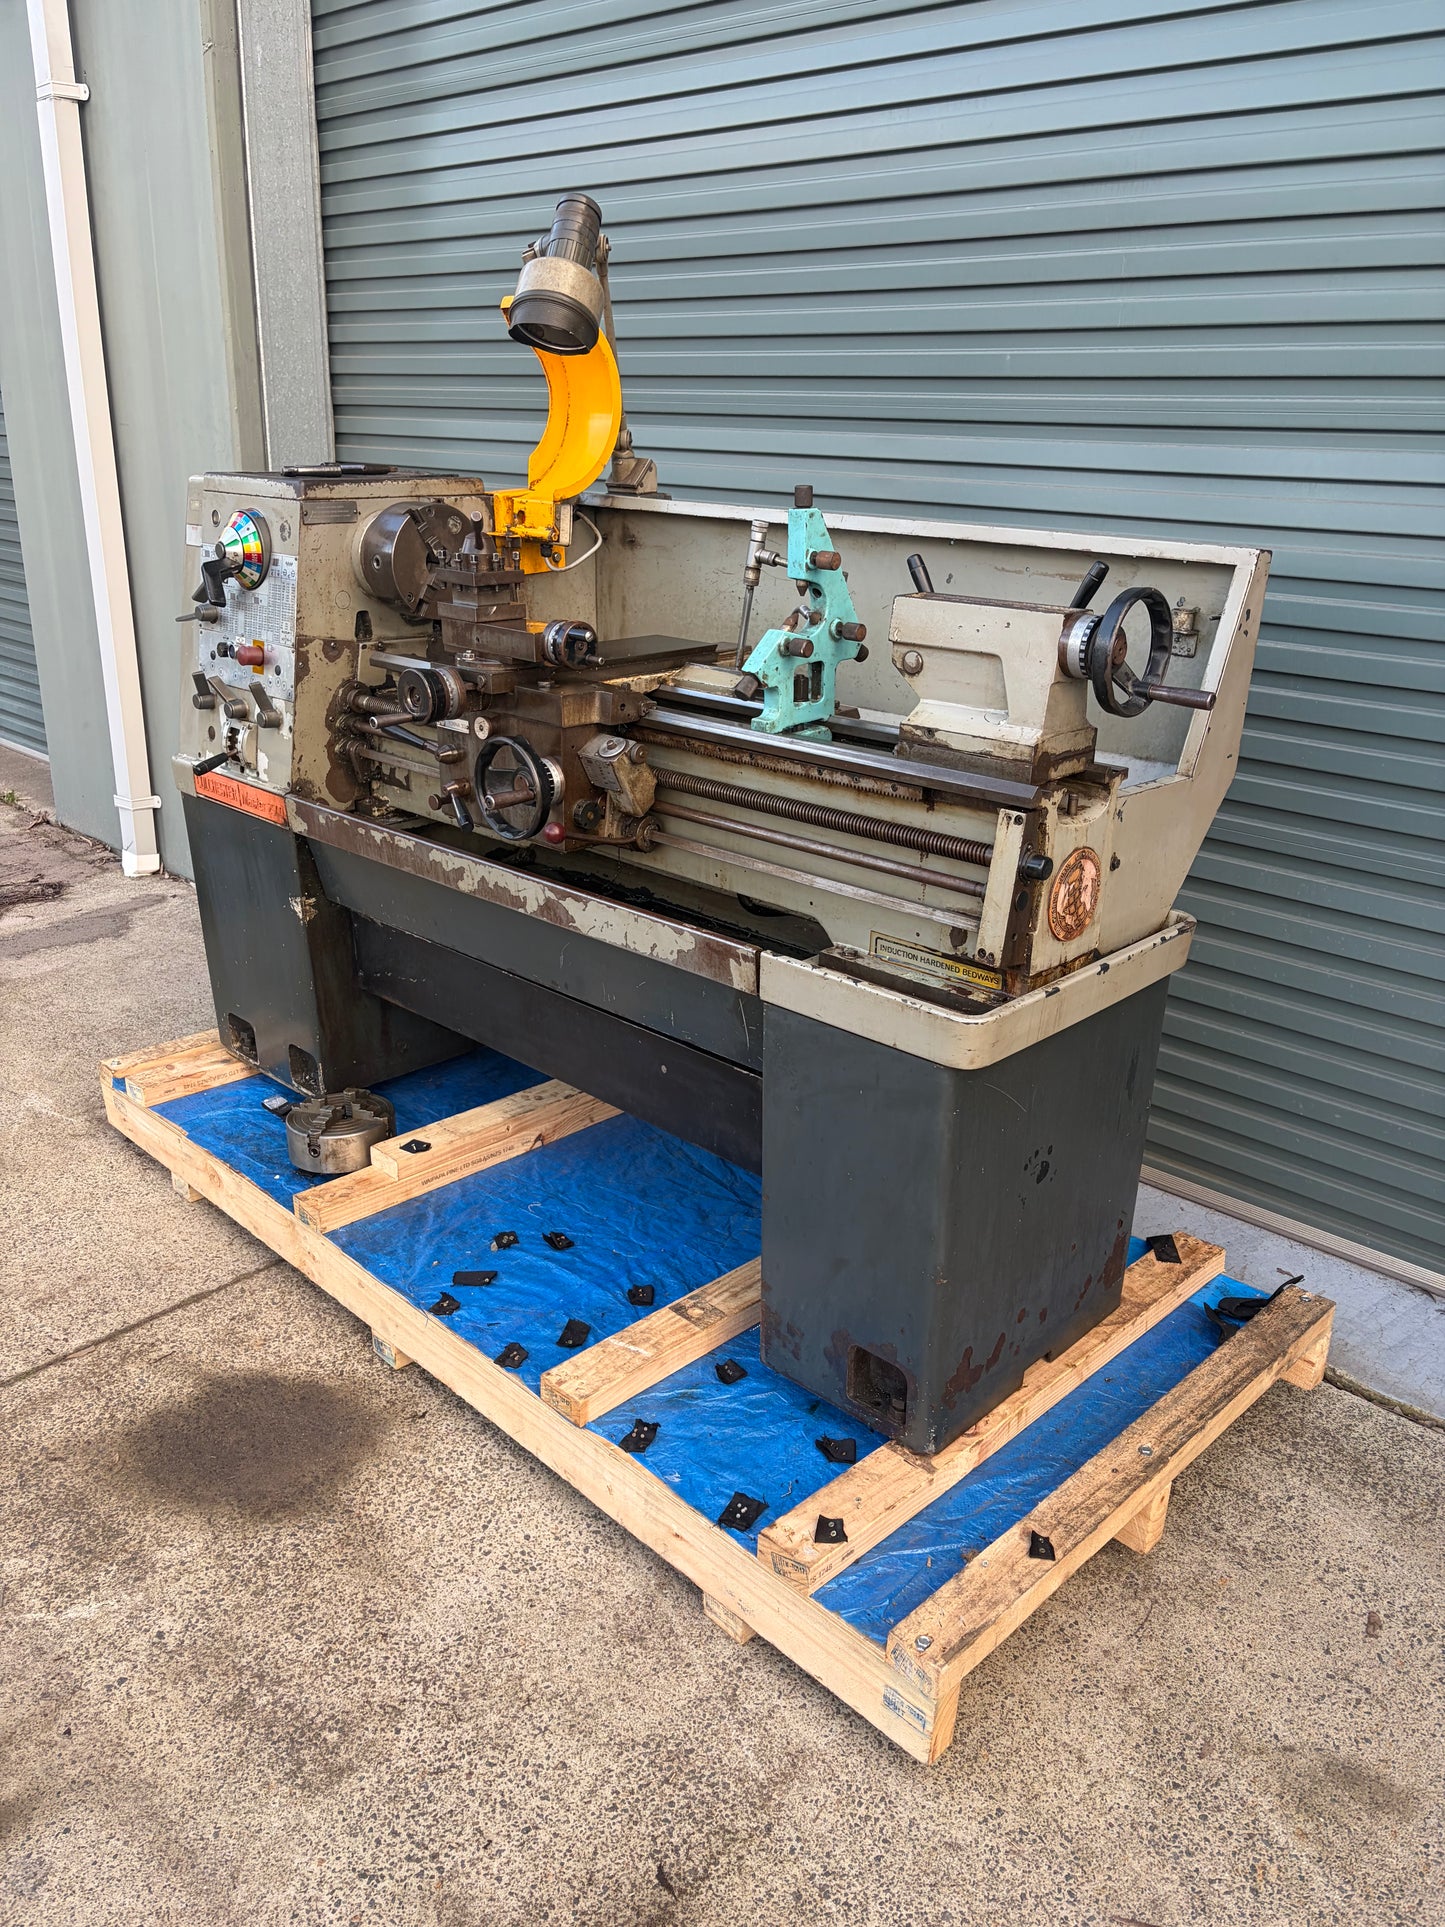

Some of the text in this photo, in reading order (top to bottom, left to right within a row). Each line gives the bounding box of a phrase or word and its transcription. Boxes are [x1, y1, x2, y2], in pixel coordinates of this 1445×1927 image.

[880, 944, 1000, 985] INDUCTION HARDENED BEDWAYS
[460, 1162, 471, 1172] LTD
